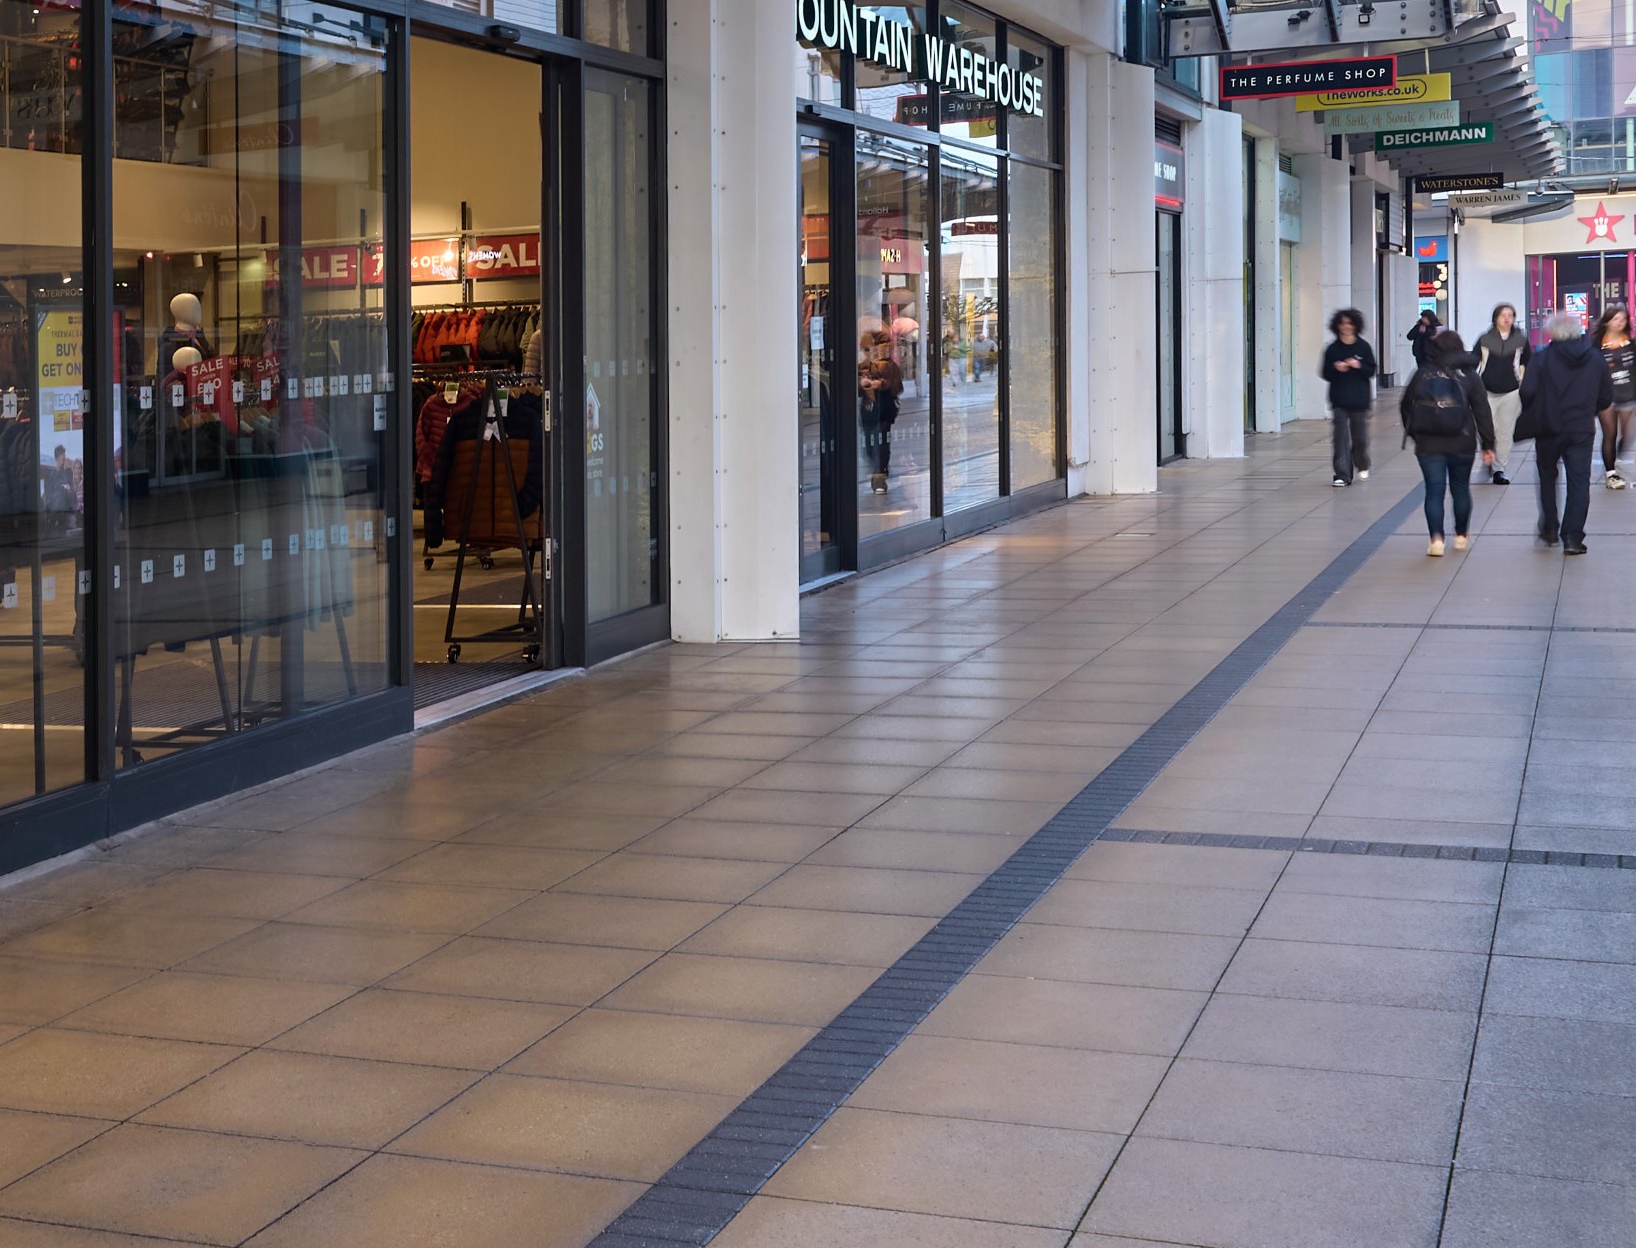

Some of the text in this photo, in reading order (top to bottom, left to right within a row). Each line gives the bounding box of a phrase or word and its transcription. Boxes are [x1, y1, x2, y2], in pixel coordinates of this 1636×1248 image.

[925, 33, 1044, 118] WAREHOUSE
[1230, 67, 1386, 88] THE PERFUME SHOP
[1329, 115, 1341, 128] All
[1346, 113, 1369, 129] Sorts
[1373, 113, 1381, 128] of
[1386, 109, 1415, 126] Sweets
[1427, 107, 1455, 123] Treats
[1383, 127, 1486, 147] DEICHMANN
[1163, 163, 1177, 182] SHOP
[1421, 176, 1500, 189] WATERSTONE'S
[1455, 192, 1522, 205] WARREN JAMES
[51, 330, 74, 338] THERMAL
[56, 343, 77, 357] BUY
[42, 362, 82, 377] GET ON
[192, 358, 224, 377] SALE
[256, 357, 280, 372] SAL
